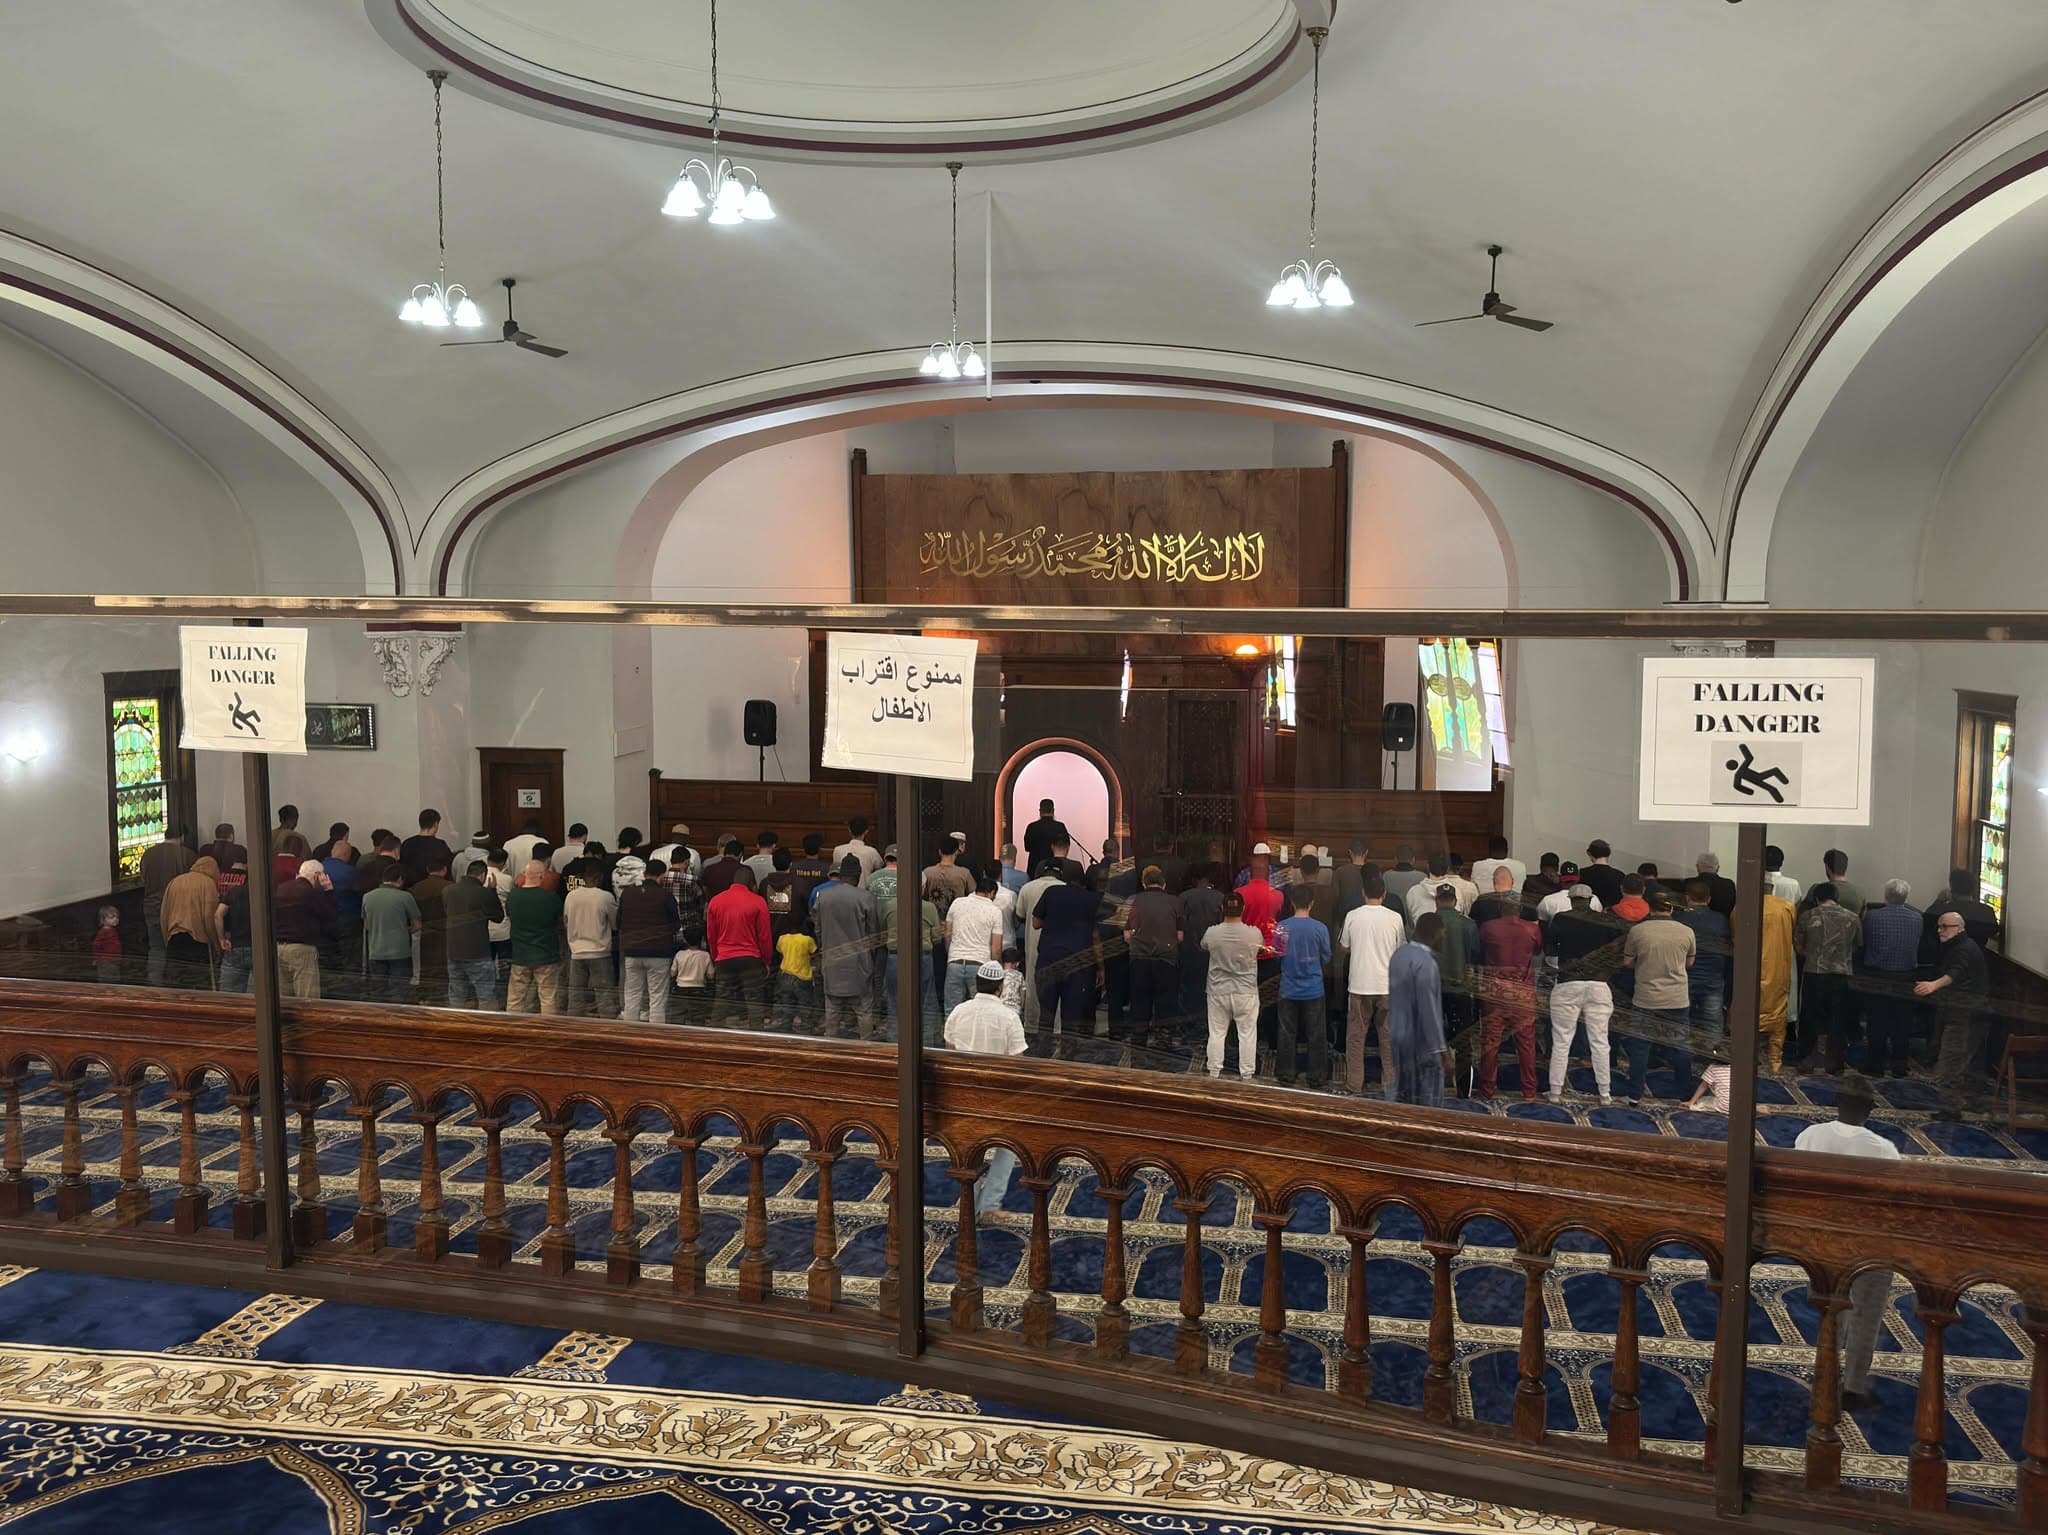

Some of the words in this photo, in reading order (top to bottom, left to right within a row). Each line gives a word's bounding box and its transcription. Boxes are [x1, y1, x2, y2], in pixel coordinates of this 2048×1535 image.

[208, 645, 277, 662] FALLING
[211, 668, 276, 685] DANGER
[841, 656, 898, 686] اقتراب
[905, 662, 962, 693] ممنوع
[1691, 682, 1824, 702] FALLING
[871, 694, 931, 723] الأطفال
[1694, 713, 1822, 734] DANGER
